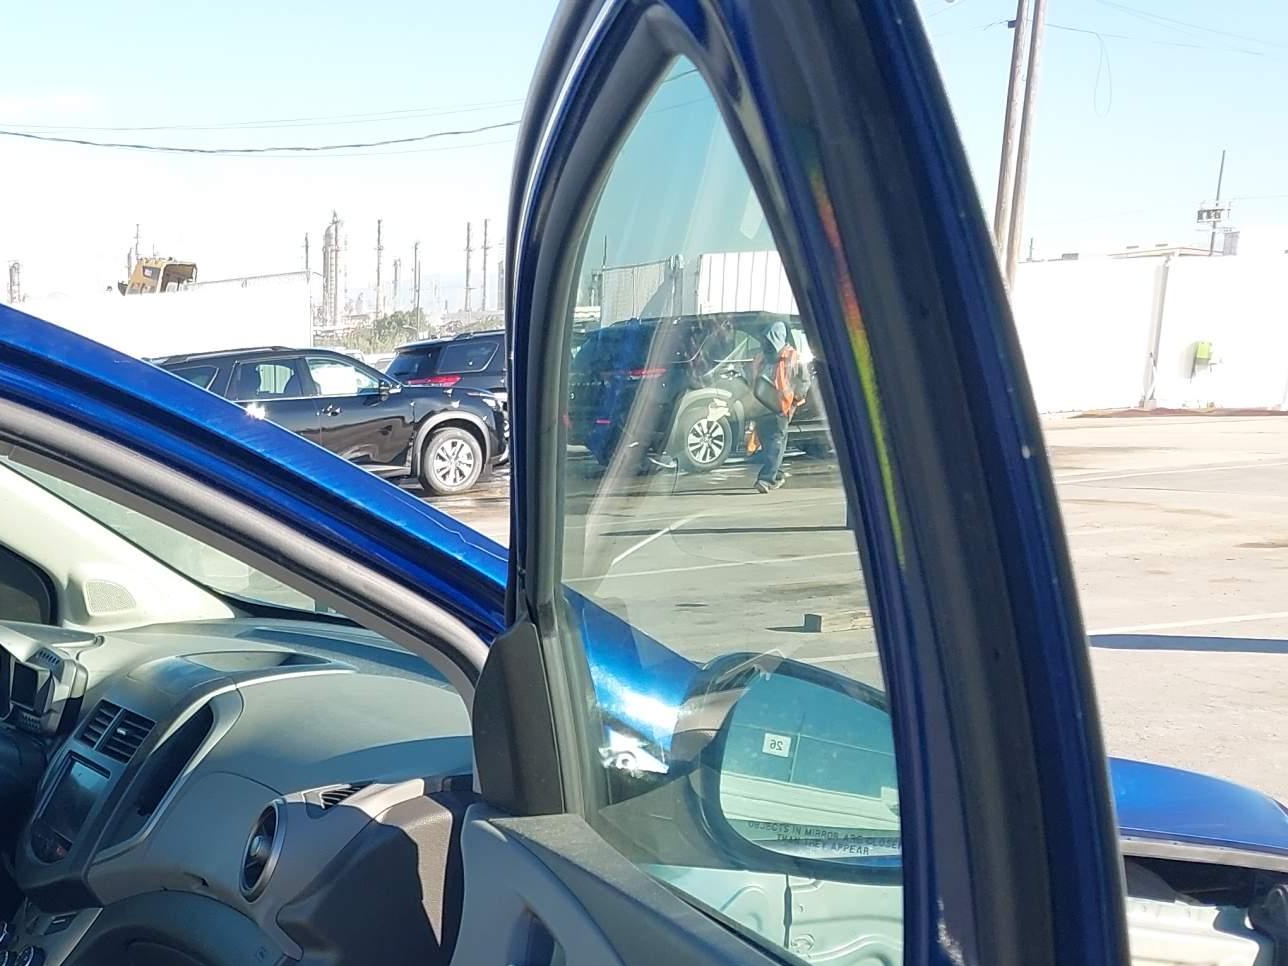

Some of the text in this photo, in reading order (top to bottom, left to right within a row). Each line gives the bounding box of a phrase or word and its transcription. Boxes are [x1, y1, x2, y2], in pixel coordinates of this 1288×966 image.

[792, 825, 801, 835] IN
[804, 828, 839, 841] MIRROR
[831, 842, 870, 855] APPEAR
